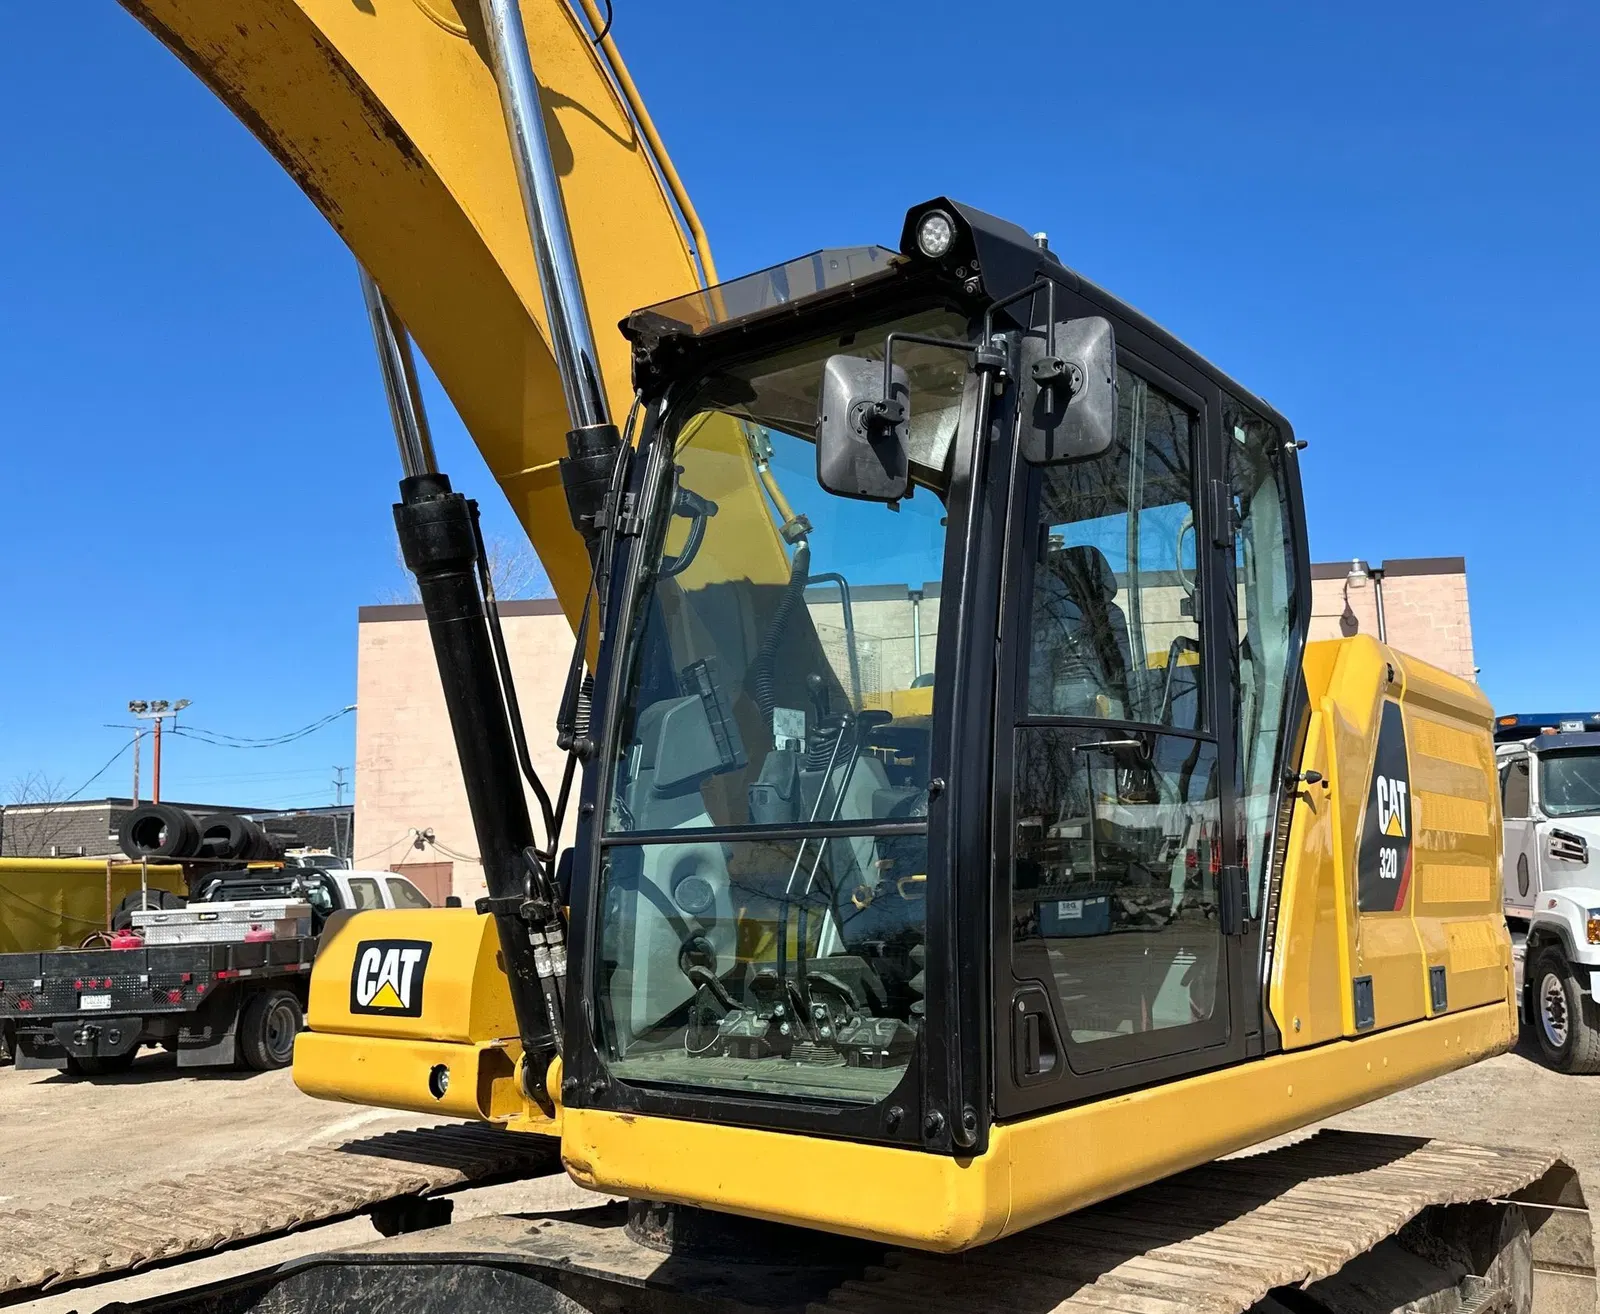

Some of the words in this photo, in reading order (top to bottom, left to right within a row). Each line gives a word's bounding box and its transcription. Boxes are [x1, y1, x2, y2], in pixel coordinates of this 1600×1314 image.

[1377, 775, 1406, 837] CAT
[1379, 847, 1397, 879] 320
[356, 947, 423, 1009] CAT
